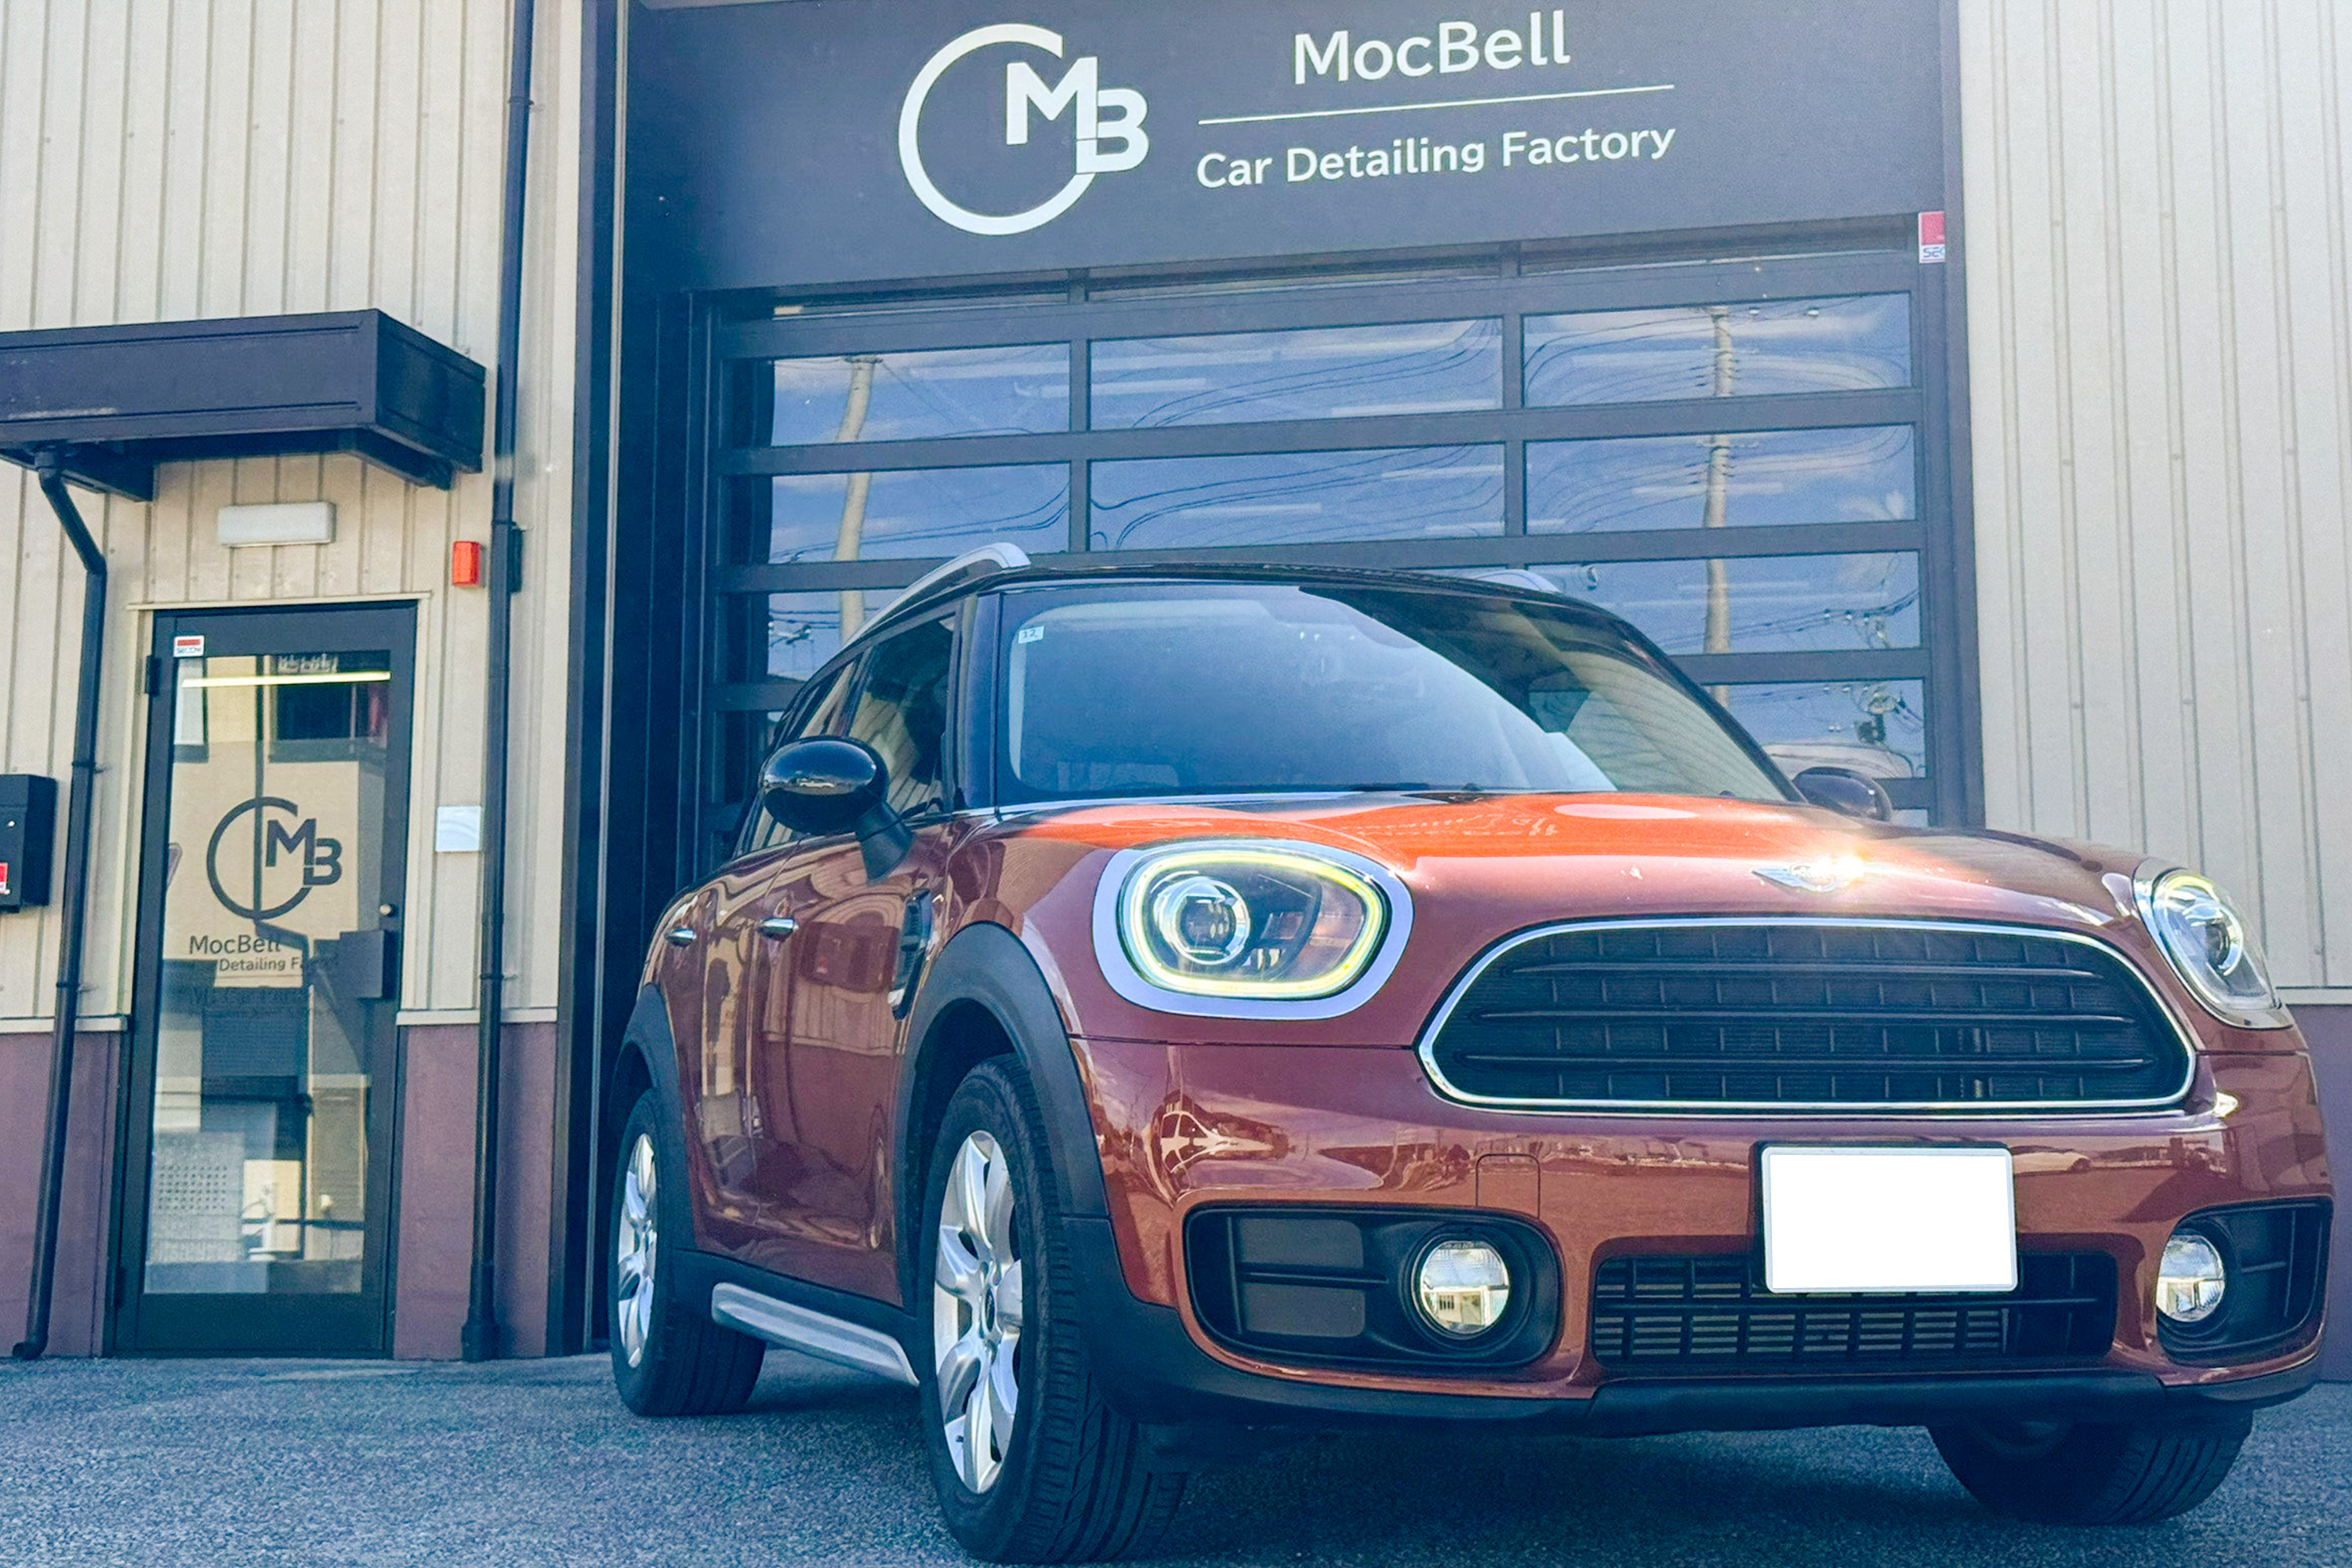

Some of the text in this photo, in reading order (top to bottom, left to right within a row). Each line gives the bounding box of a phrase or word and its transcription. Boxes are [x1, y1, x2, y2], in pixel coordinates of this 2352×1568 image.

[1294, 9, 1572, 85] MocBell
[1196, 128, 1676, 189] Car Detailing Factory
[219, 956, 286, 972] Detailing
